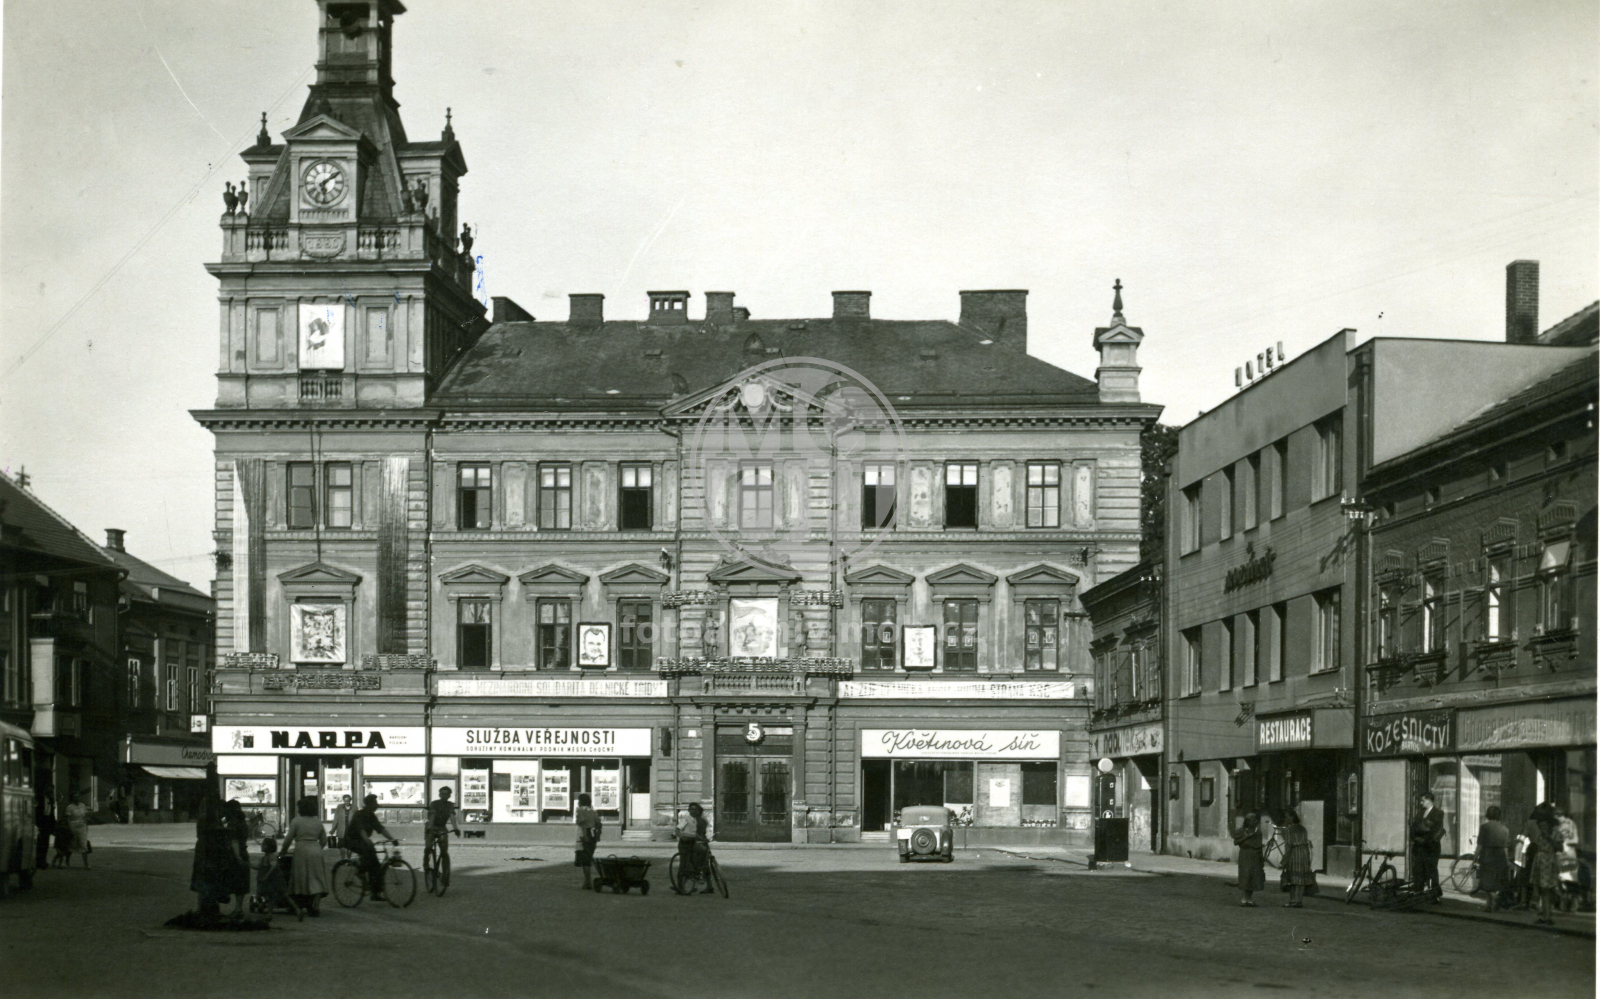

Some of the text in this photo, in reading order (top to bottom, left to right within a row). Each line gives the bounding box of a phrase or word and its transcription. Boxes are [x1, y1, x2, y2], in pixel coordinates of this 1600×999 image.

[270, 731, 386, 749] NARPA
[466, 728, 615, 745] SLUŽBA VEŘEJNOSTI
[746, 723, 760, 741] 5
[1260, 717, 1311, 745] RESTAURACE
[881, 730, 1041, 754] Květinová síň
